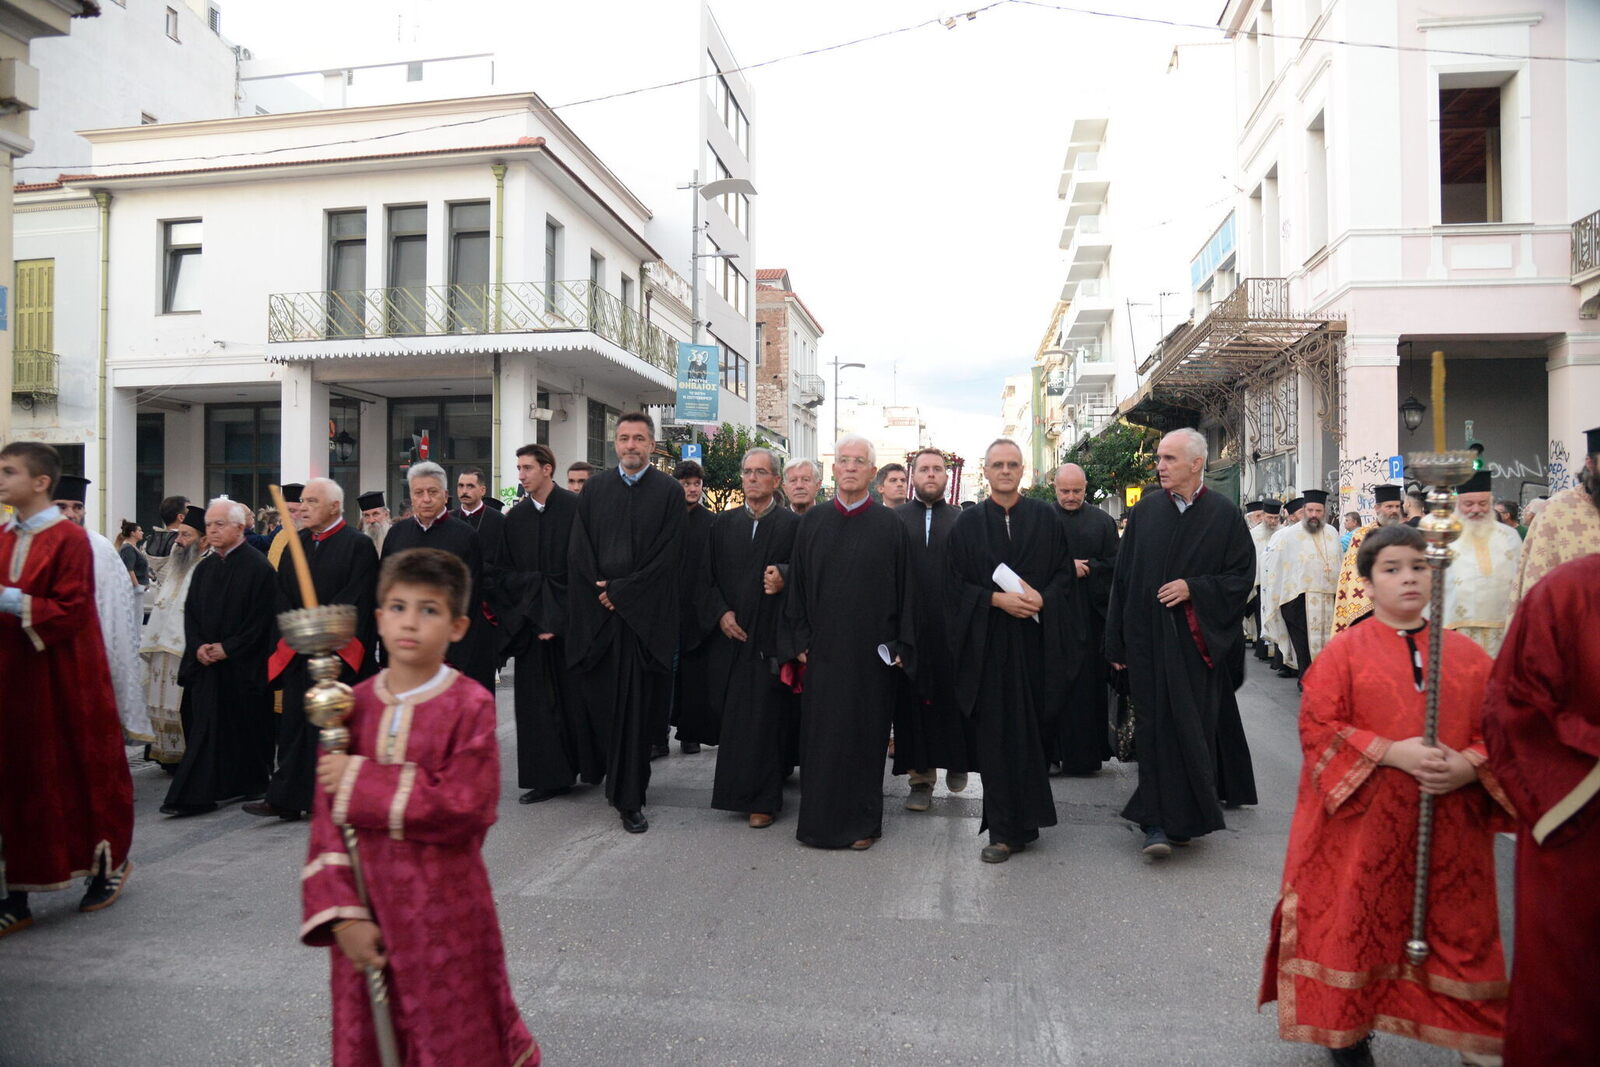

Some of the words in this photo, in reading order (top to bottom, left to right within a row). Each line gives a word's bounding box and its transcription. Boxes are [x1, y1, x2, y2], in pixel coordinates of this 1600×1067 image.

[679, 382, 717, 391] ΘΗΒΑΙΟΣ
[688, 445, 696, 456] P
[1393, 460, 1400, 478] P
